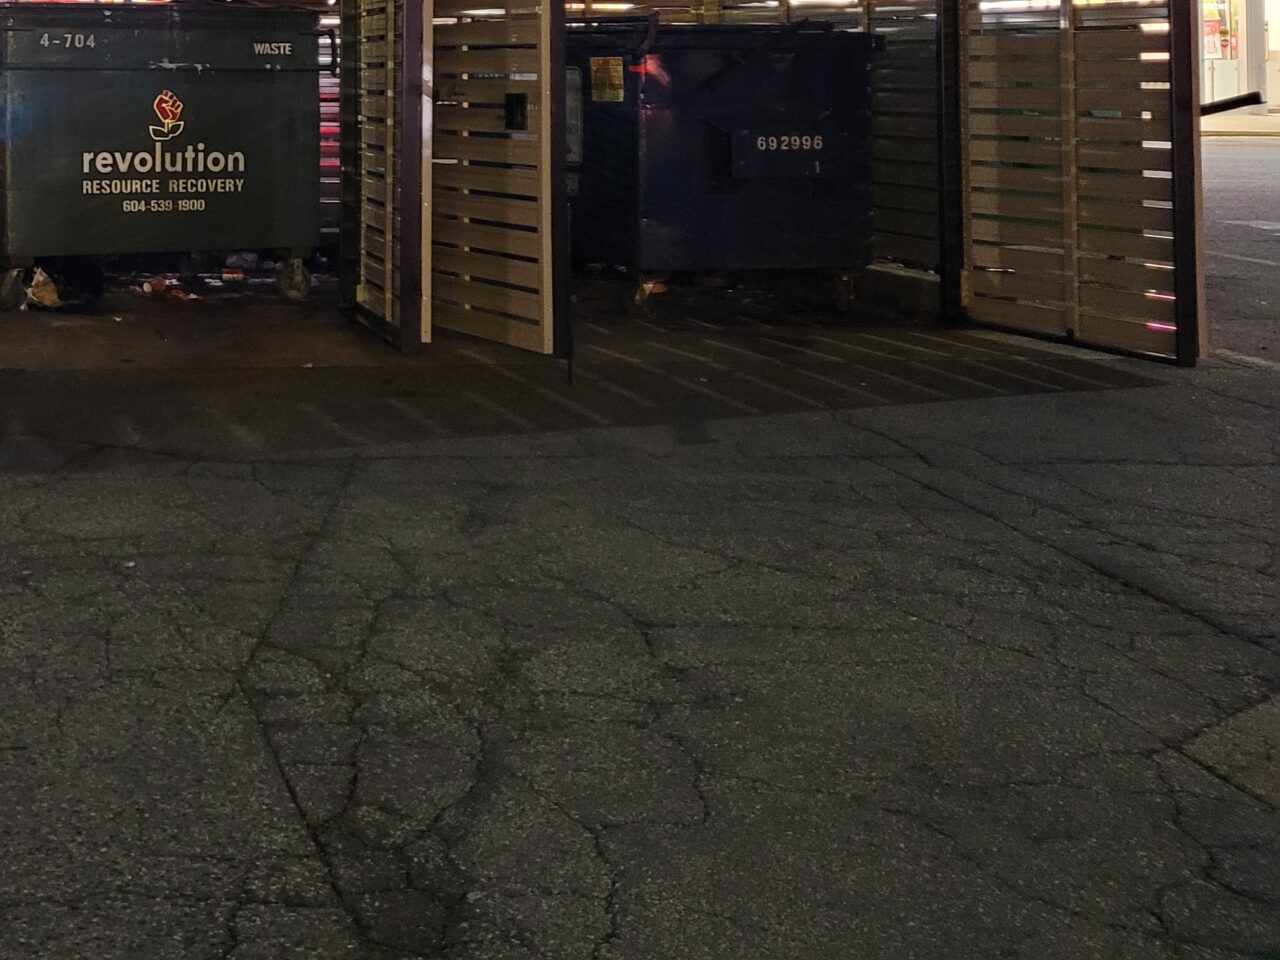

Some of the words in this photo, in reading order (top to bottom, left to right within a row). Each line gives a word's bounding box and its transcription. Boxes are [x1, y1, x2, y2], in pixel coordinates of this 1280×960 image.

[40, 33, 97, 49] 4-704
[253, 42, 293, 56] WASTE
[756, 135, 824, 151] 692996
[82, 141, 246, 174] revolution
[82, 178, 161, 195] RESOURCE
[168, 177, 245, 194] RECOVERY
